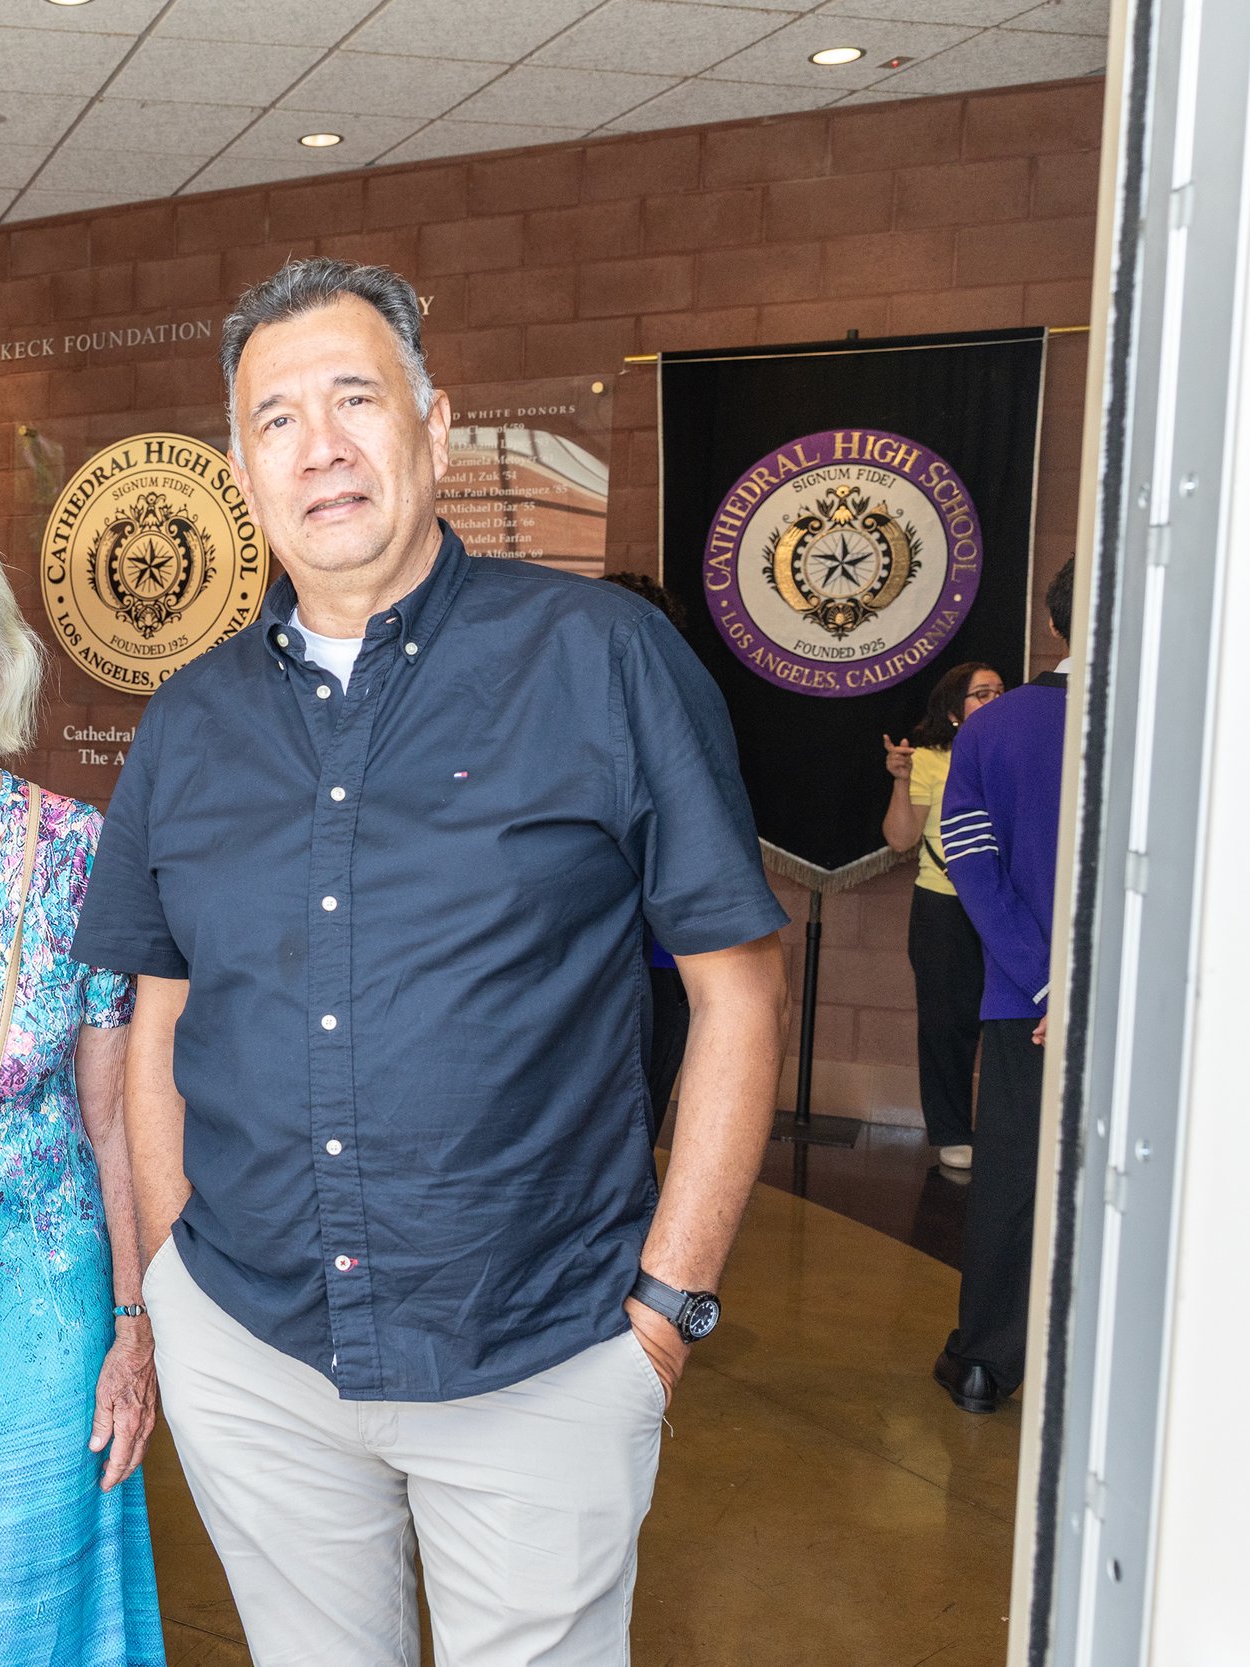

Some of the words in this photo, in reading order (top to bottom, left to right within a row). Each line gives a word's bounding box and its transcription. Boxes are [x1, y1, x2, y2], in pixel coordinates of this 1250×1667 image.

[0, 338, 54, 361] KECK
[64, 320, 212, 353] FOUNDATION
[468, 409, 511, 419] WHITE
[517, 405, 576, 417] DONORS
[449, 455, 491, 467] Carmela
[469, 472, 477, 483] J.
[478, 471, 500, 481] Zuk
[792, 468, 851, 492] SIGNUM
[856, 468, 897, 489] FIDEI
[112, 477, 159, 500] SIGNUM
[162, 477, 195, 498] FIDEI
[444, 489, 462, 498] Mr.
[464, 486, 487, 497] Paul
[47, 450, 138, 585] CATHEDRAL
[144, 441, 212, 478] HIGH
[210, 468, 259, 581] SCHOOL
[450, 502, 491, 513] Michael
[706, 443, 821, 591] CATHEDRAL
[833, 431, 922, 473] HIGH
[918, 461, 978, 583] SCHOOL
[450, 518, 491, 529] Michael
[466, 533, 497, 544] Adela
[500, 533, 532, 544] Farfan
[486, 548, 526, 558] Alfonso
[57, 611, 83, 646] LOS
[78, 648, 154, 688] ANGELES,
[109, 635, 166, 656] FOUNDED
[168, 634, 189, 652] 1925
[720, 611, 754, 650] LOS
[845, 608, 959, 689] CALIFORNIA
[793, 639, 856, 659] FOUNDED
[859, 637, 886, 656] 1925
[63, 725, 136, 742] Cathedral
[78, 749, 108, 765] The
